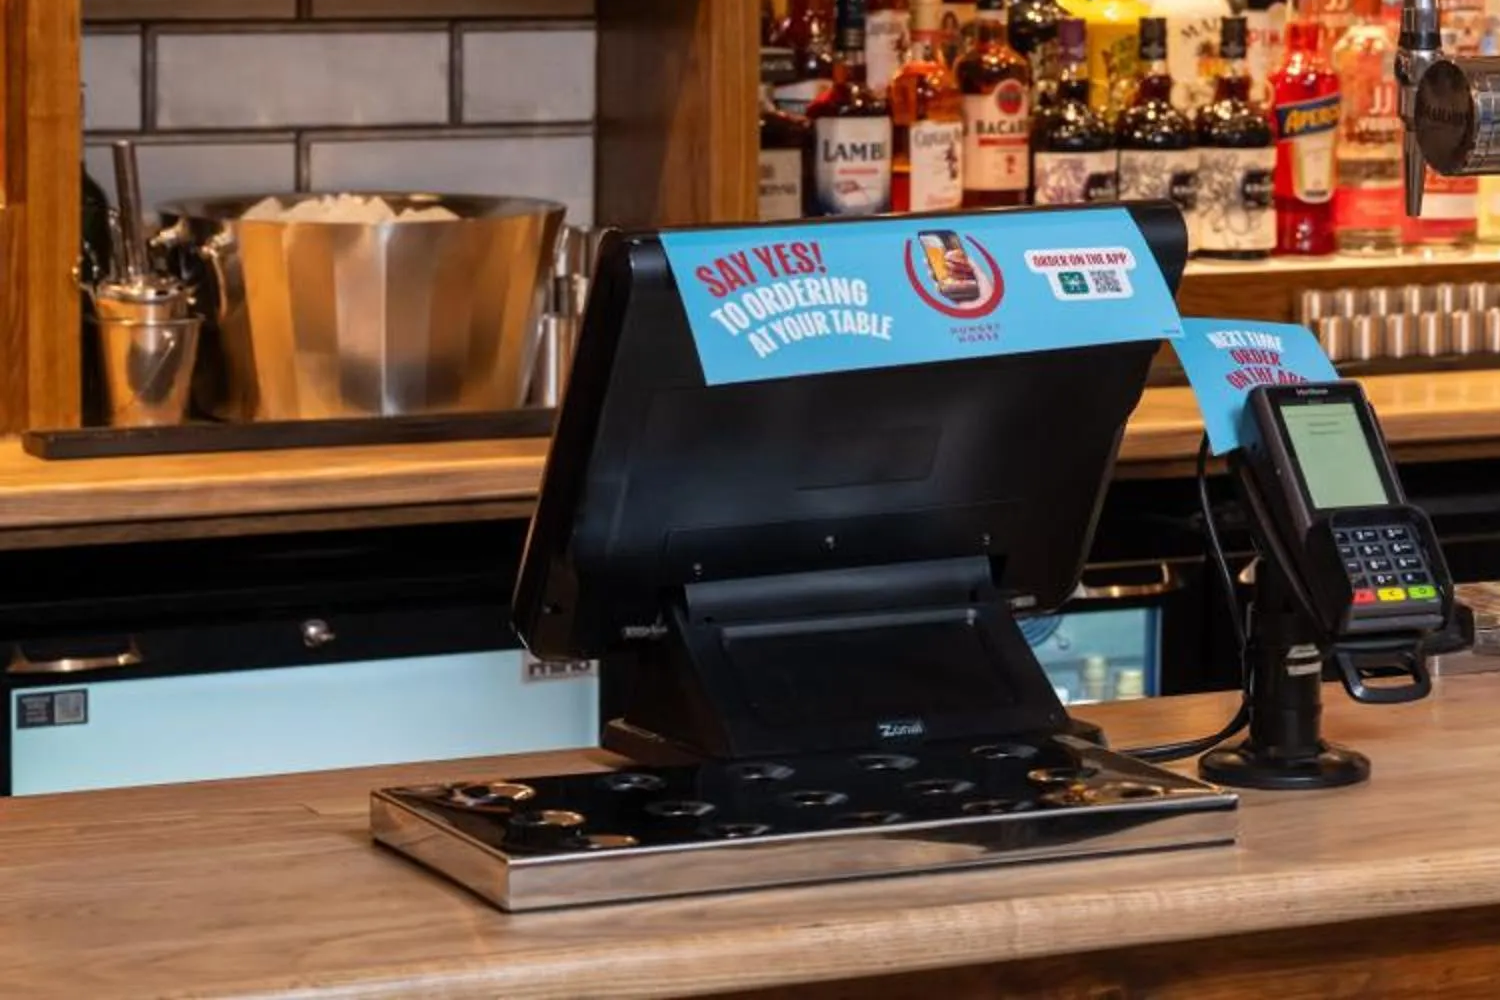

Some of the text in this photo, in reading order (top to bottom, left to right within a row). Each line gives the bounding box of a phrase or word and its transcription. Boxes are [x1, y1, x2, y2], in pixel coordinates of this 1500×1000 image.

[695, 241, 827, 298] SAY YES!
[1032, 252, 1129, 267] ORDER ON THE APP
[710, 276, 869, 336] TO ORDERING
[748, 308, 894, 359] AT YOUR TABLE
[1229, 348, 1282, 366] ORDER
